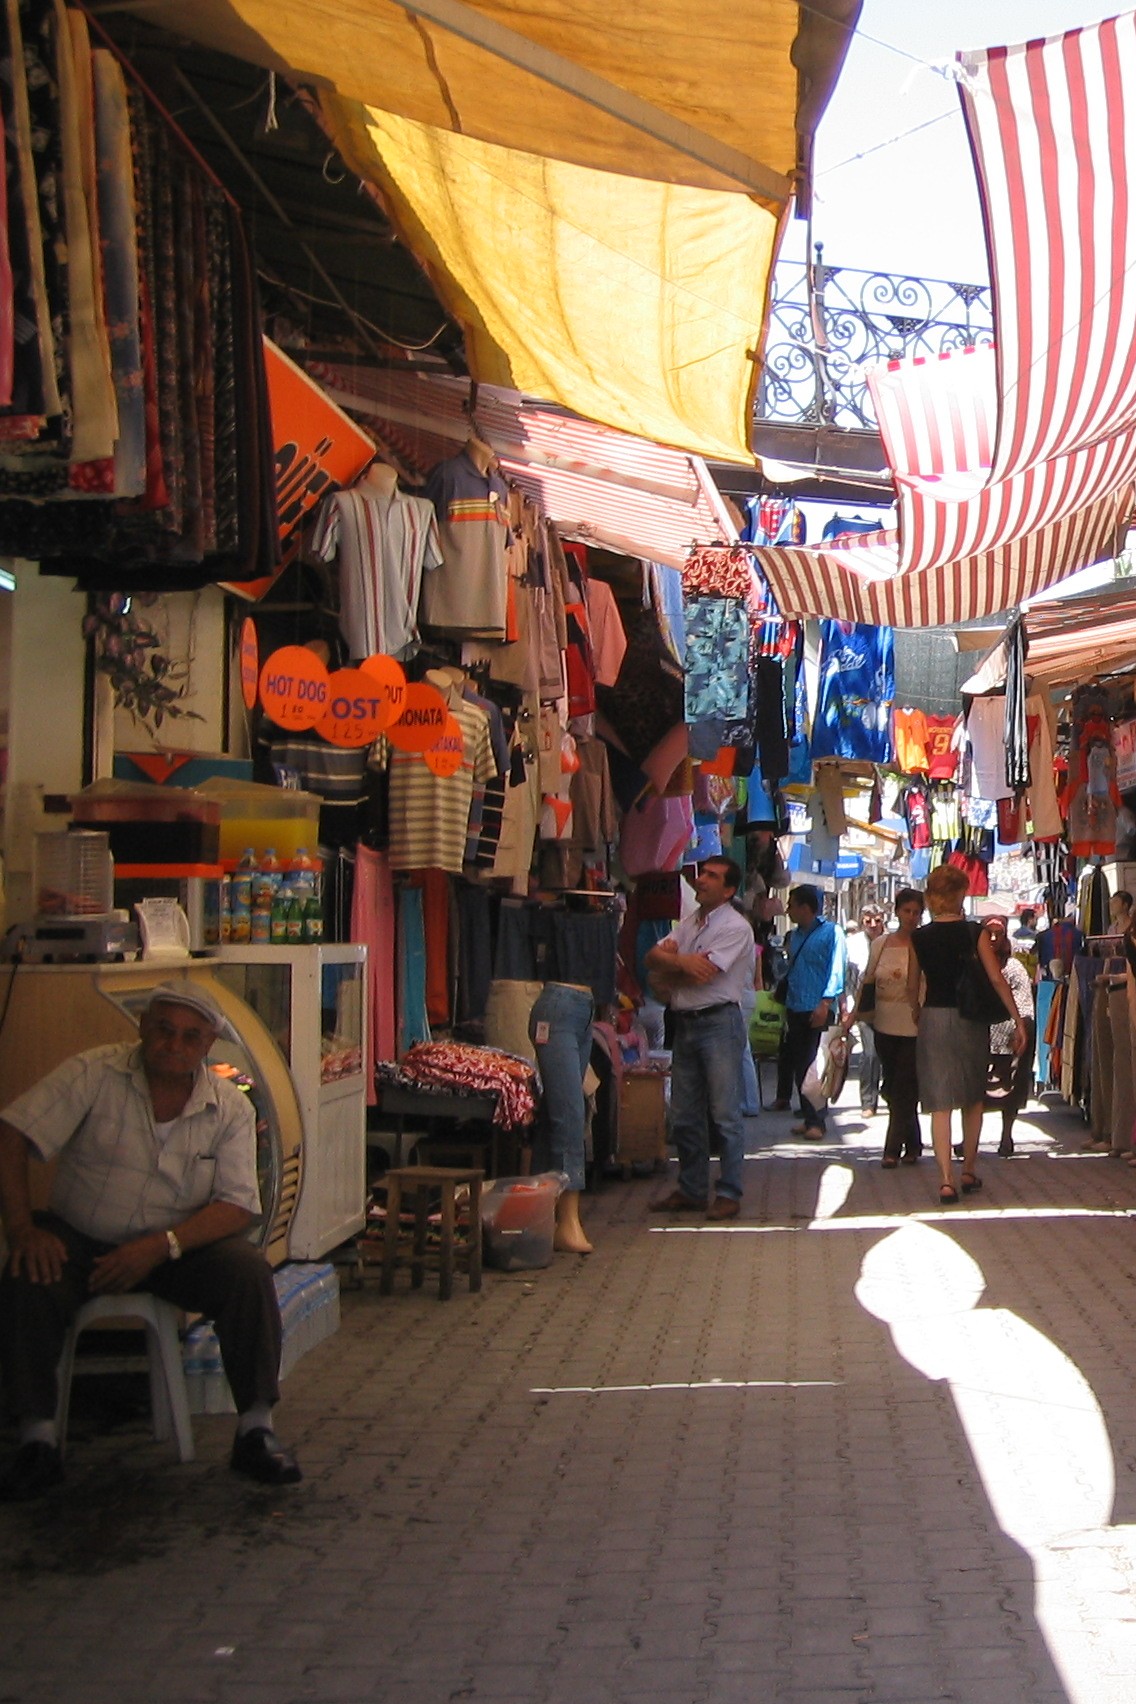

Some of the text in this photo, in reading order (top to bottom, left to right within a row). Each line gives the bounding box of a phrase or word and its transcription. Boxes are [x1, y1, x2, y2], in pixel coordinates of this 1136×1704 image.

[266, 674, 294, 697] HOT
[297, 679, 327, 703] DOG
[325, 697, 381, 719] OST
[931, 733, 951, 756] 9
